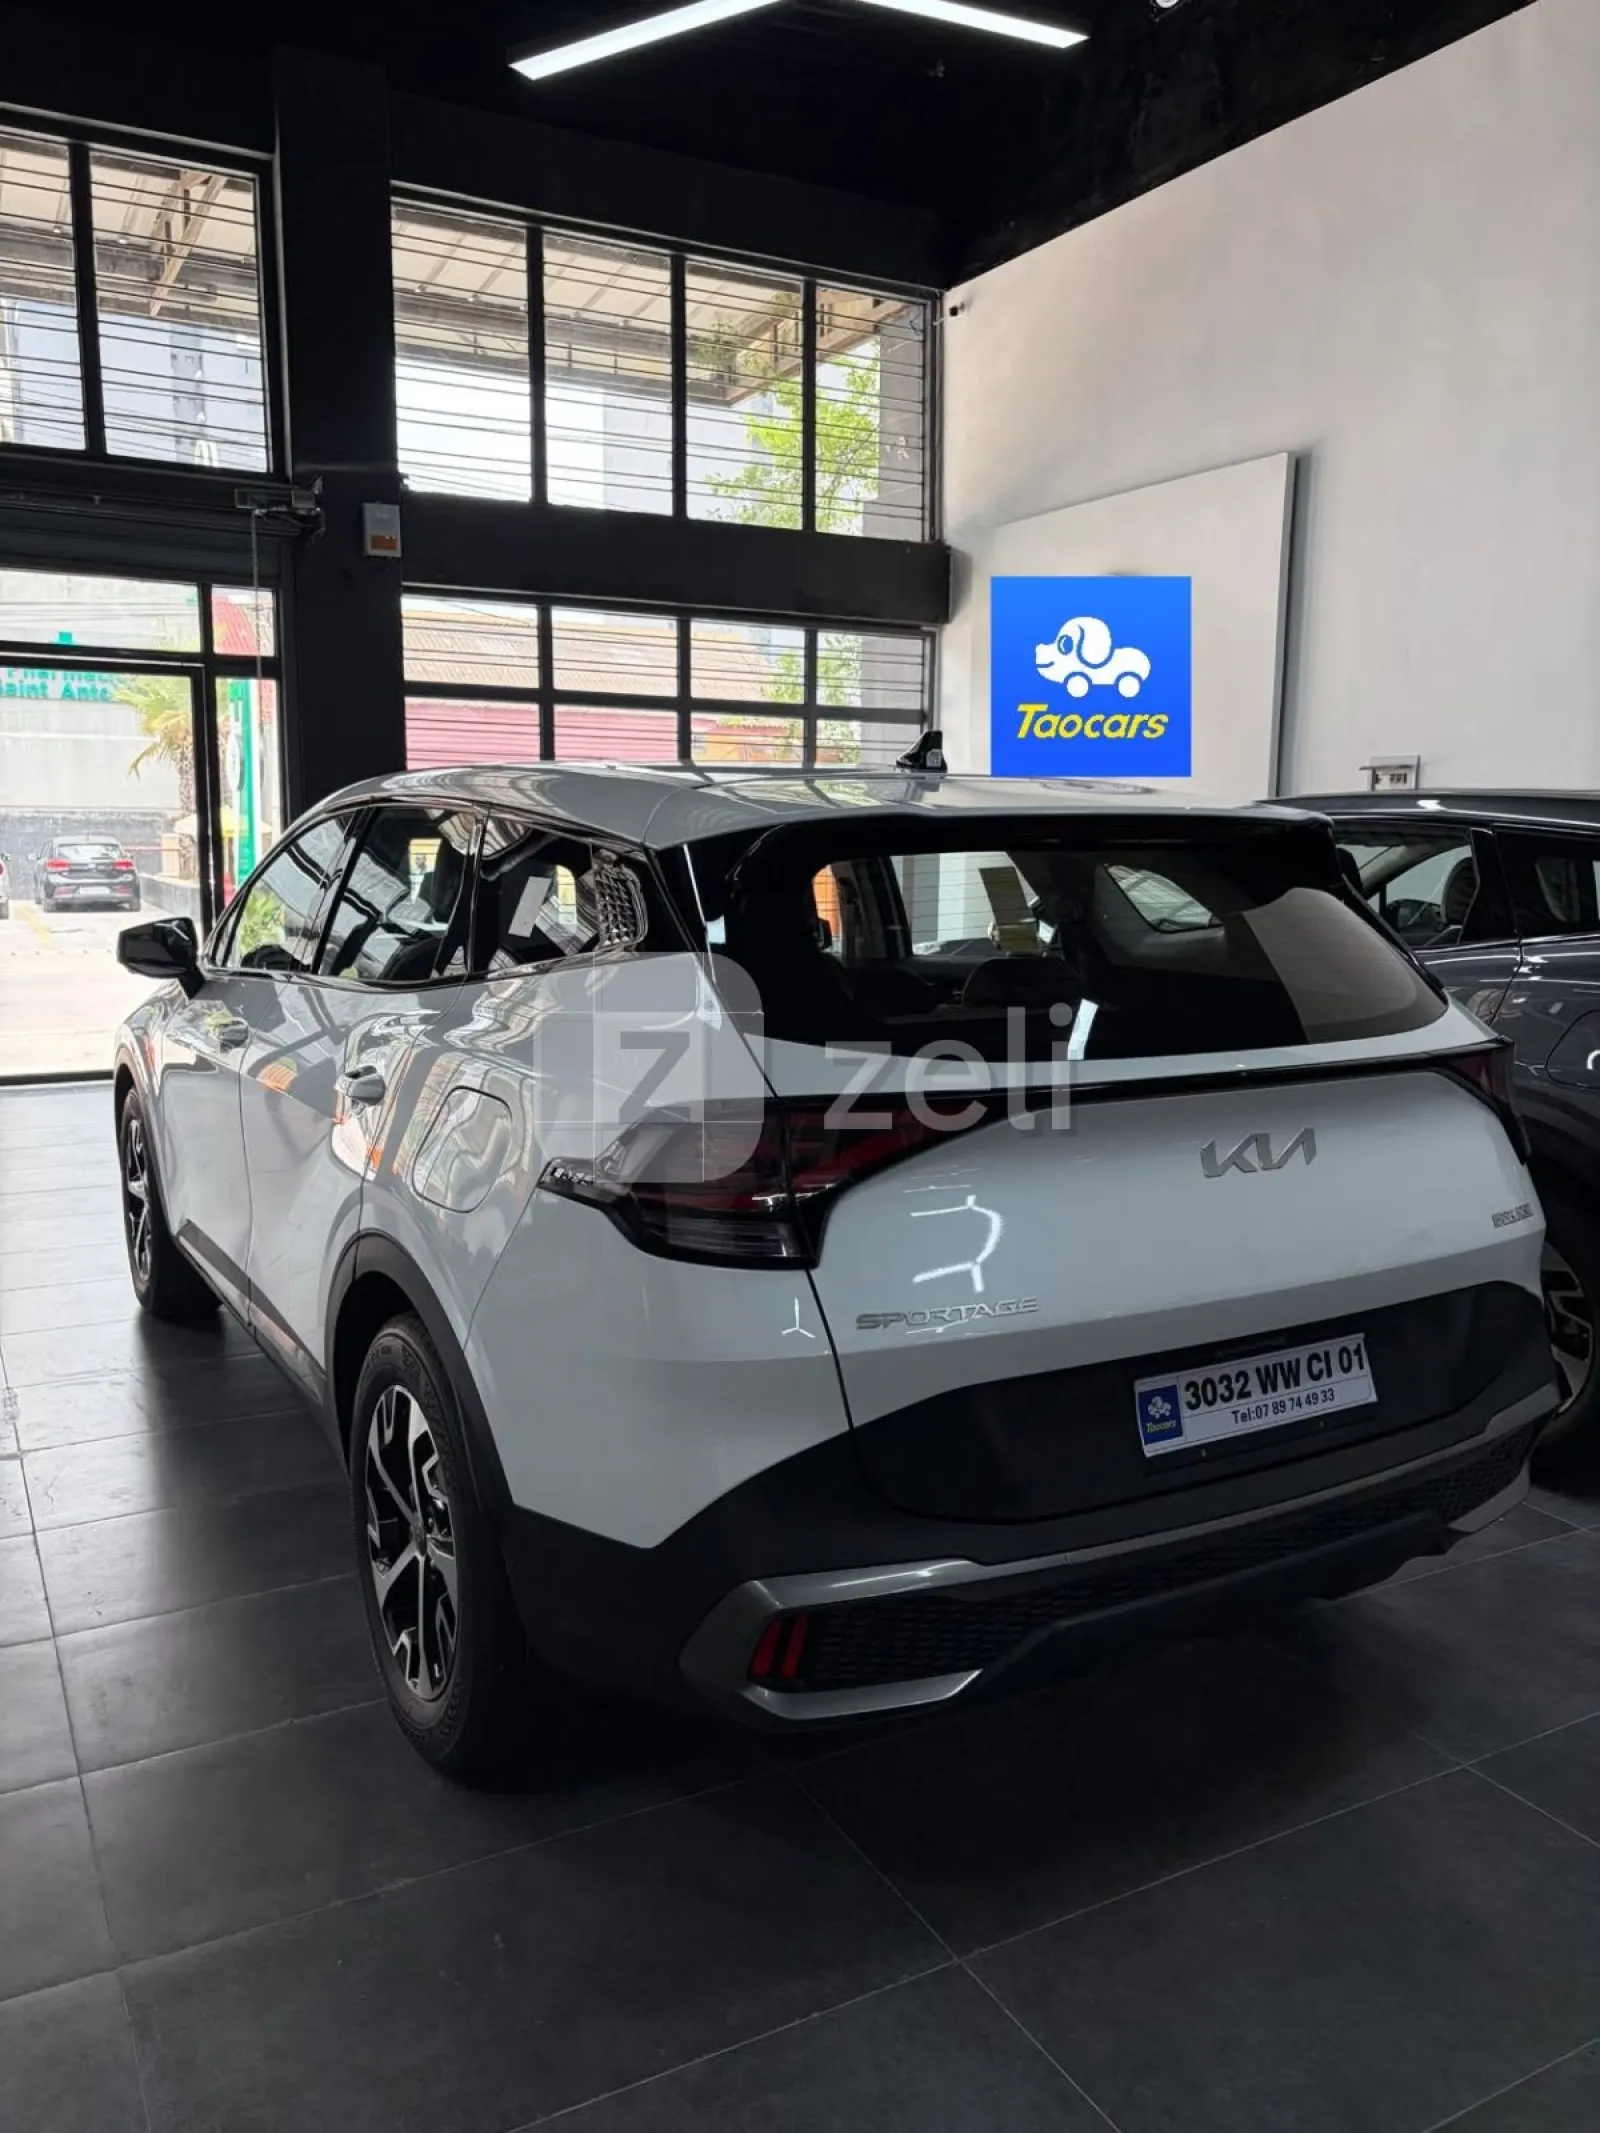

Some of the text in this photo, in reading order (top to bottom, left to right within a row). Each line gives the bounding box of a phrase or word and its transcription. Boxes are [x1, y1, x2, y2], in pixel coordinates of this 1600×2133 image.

[1200, 1127, 1317, 1178] KIA
[855, 1296, 1039, 1330] SPORTAGE
[1184, 1342, 1366, 1411] 3032 WW CI 01
[1271, 1400, 1287, 1415] 89
[1289, 1397, 1302, 1411] 74
[1304, 1394, 1320, 1407] 49
[1320, 1388, 1335, 1403] 33
